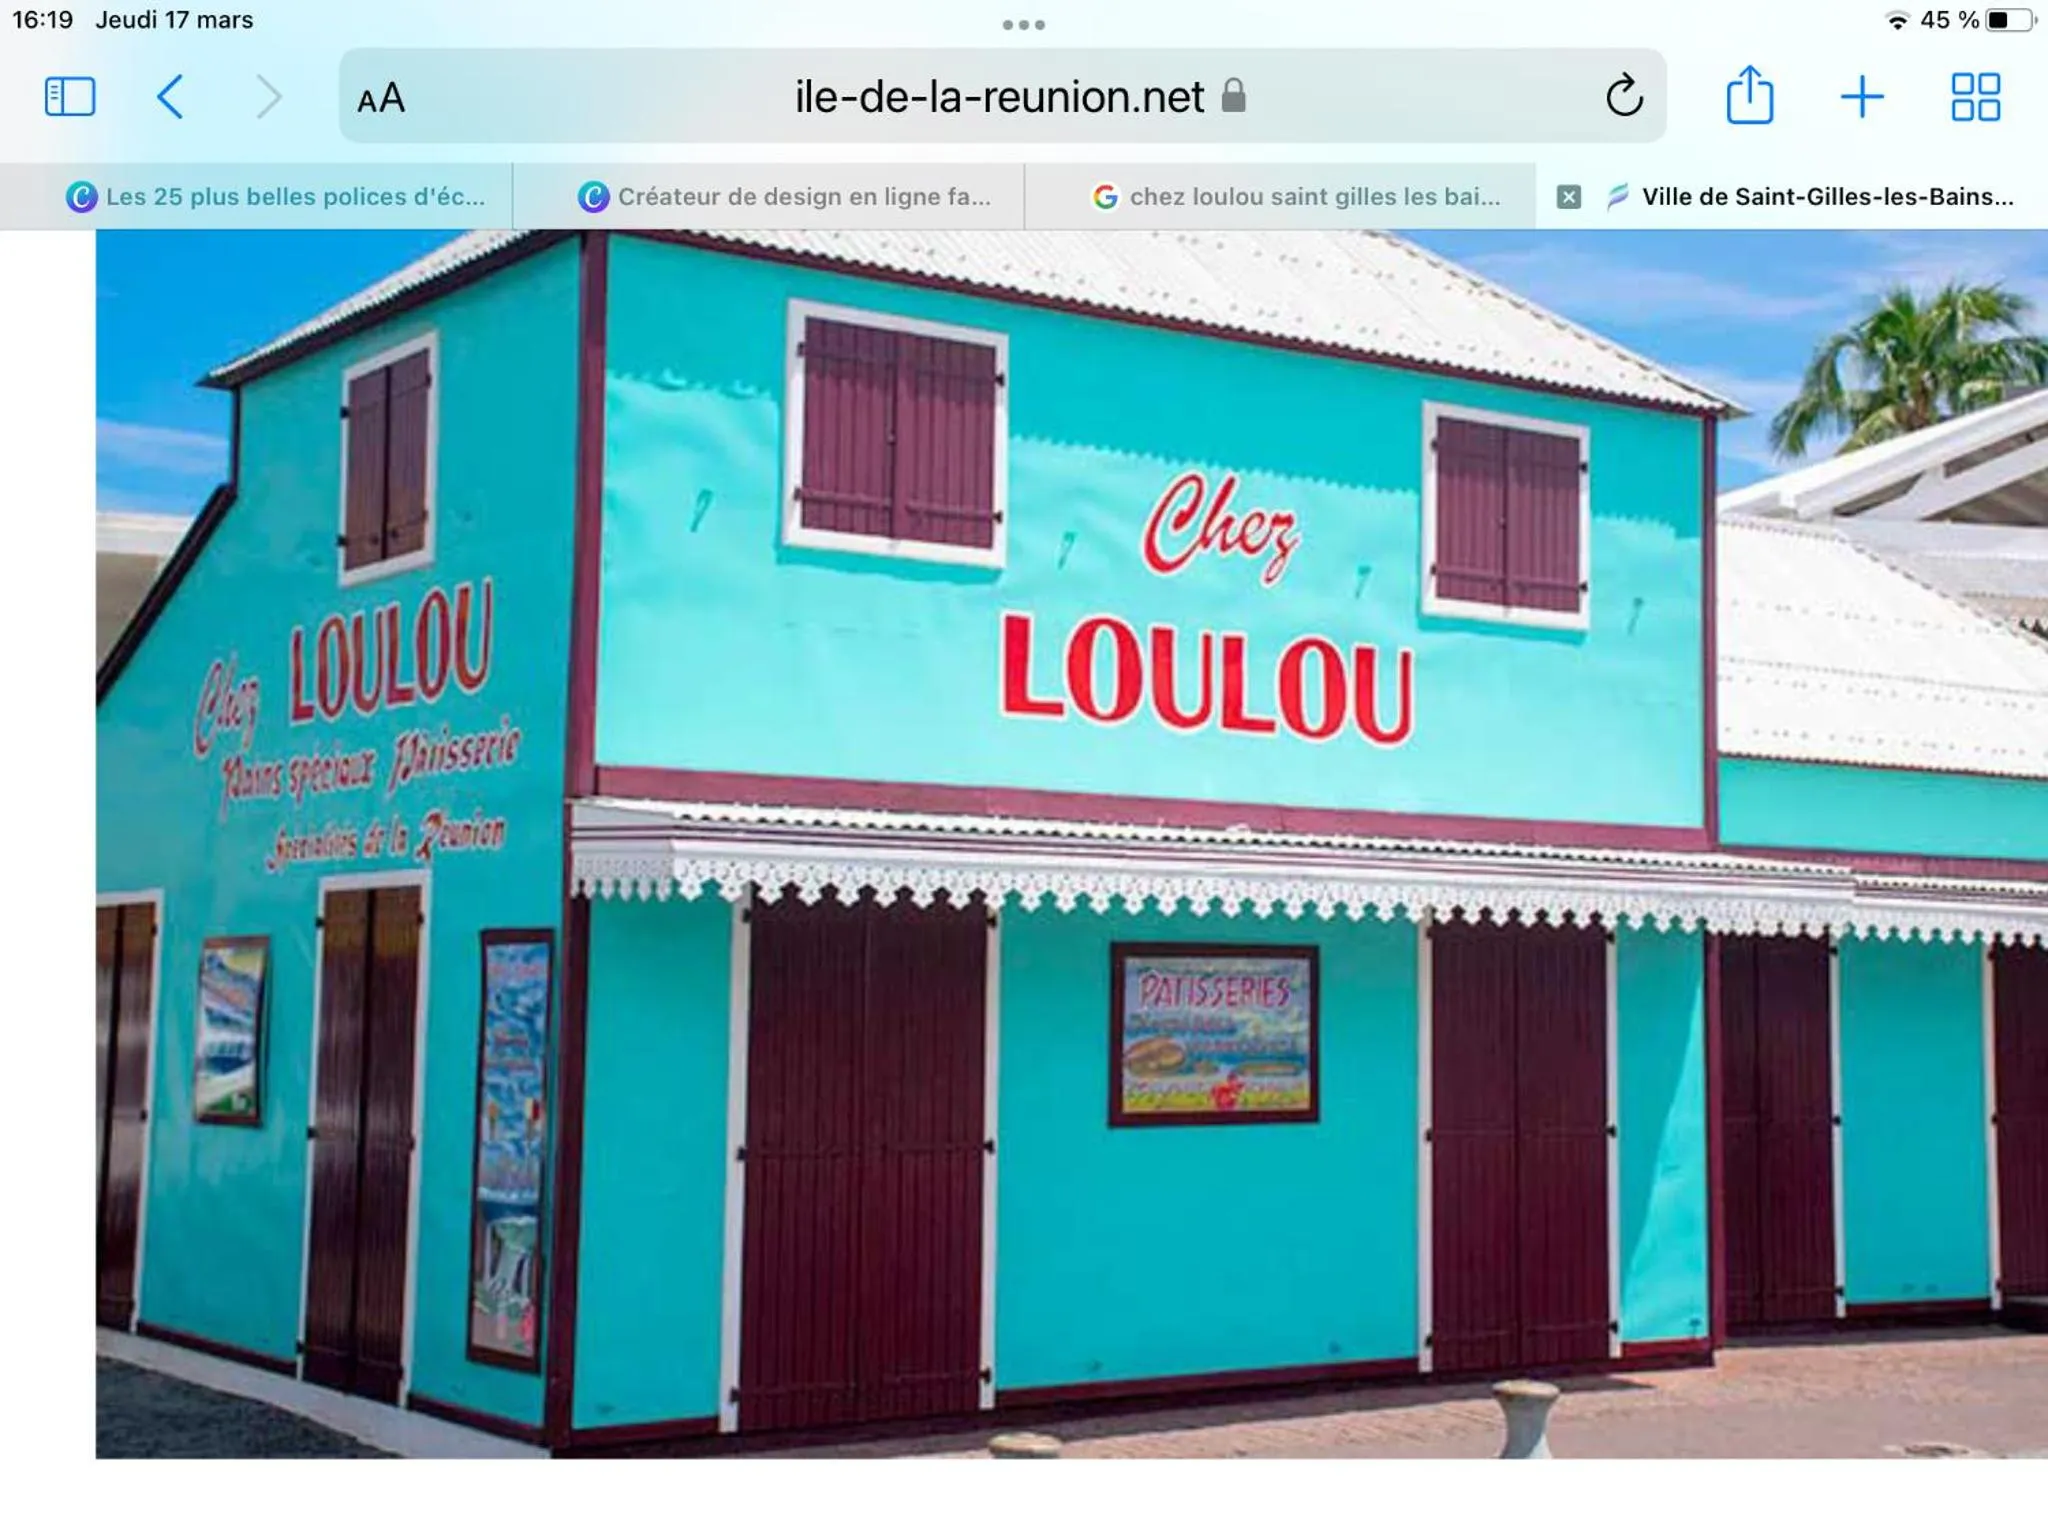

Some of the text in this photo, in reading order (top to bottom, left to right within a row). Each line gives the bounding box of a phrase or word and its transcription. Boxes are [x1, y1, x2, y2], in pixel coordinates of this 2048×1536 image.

[12, 9, 254, 30] 16:19 Jeudi 17 mars
[1920, 10, 1980, 29] 45 %
[796, 77, 1206, 114] ile-de-la-reunion.net
[107, 188, 146, 206] Les
[154, 187, 182, 206] 25
[191, 187, 239, 211] plus
[247, 187, 316, 206] belles
[324, 186, 407, 211] polices
[618, 186, 721, 207] Créateur
[728, 187, 757, 206] de
[764, 186, 841, 211] design
[849, 191, 877, 206] en
[885, 186, 940, 211] ligne
[948, 187, 991, 207] fa...
[1130, 187, 1185, 207] chez
[1193, 187, 1263, 206] loulou
[1271, 187, 1328, 206] saint
[1336, 186, 1396, 211] gilles
[1405, 186, 1437, 206] les
[1445, 186, 1500, 207] bai...
[1642, 186, 2014, 207] Ville de Saint-Gilles-les-Bains...
[1142, 468, 1300, 588] Chez
[193, 577, 492, 758] Chez LOULOU
[1001, 611, 1415, 747] LOULOU
[1139, 971, 1292, 1009] PATISSERIES
